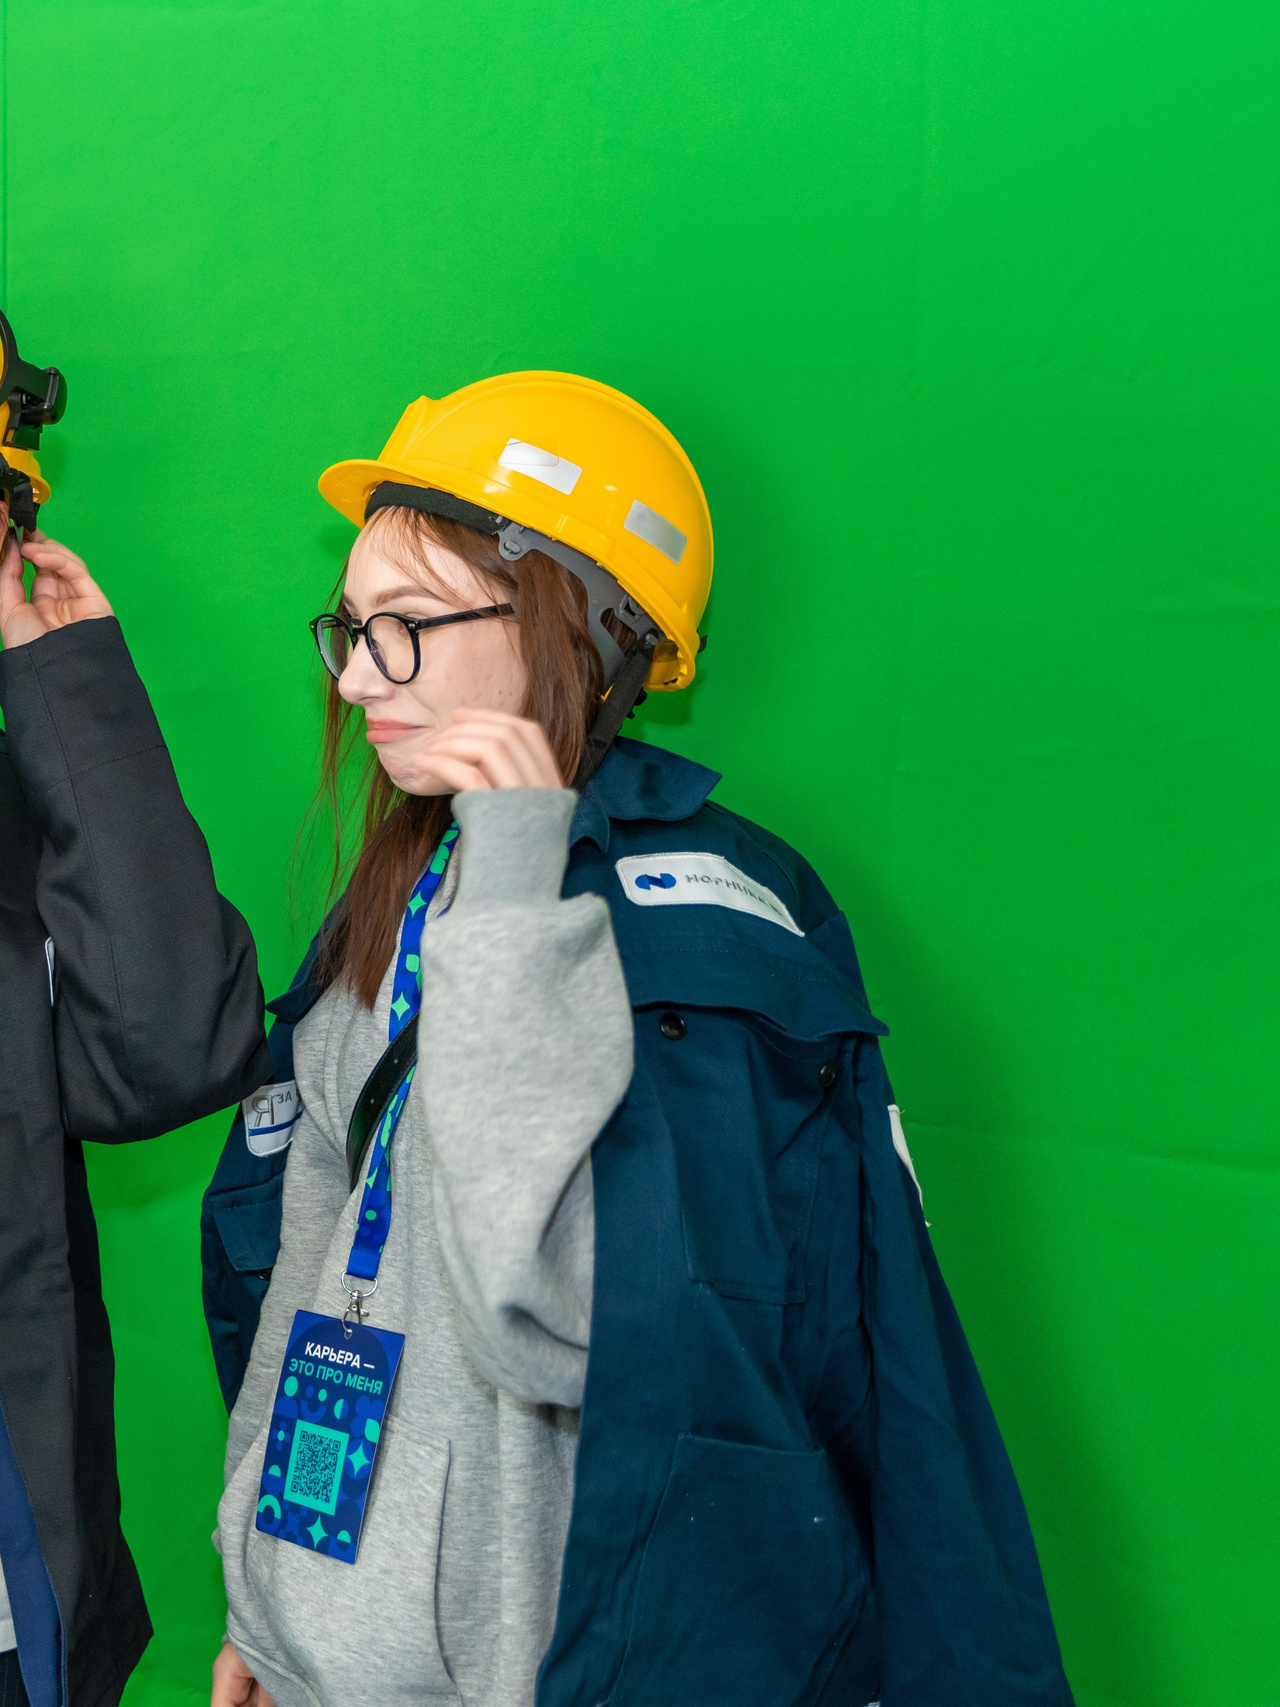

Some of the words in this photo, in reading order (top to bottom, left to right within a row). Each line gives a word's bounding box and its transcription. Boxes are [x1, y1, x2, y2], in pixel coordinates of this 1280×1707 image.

[251, 1094, 274, 1127] Я
[277, 1091, 292, 1104] ЗА
[304, 1342, 360, 1369] КАРЬЕРА
[289, 1358, 314, 1376] ЭТО
[316, 1365, 343, 1384] ПРО
[345, 1373, 384, 1395] МЕНЯ
